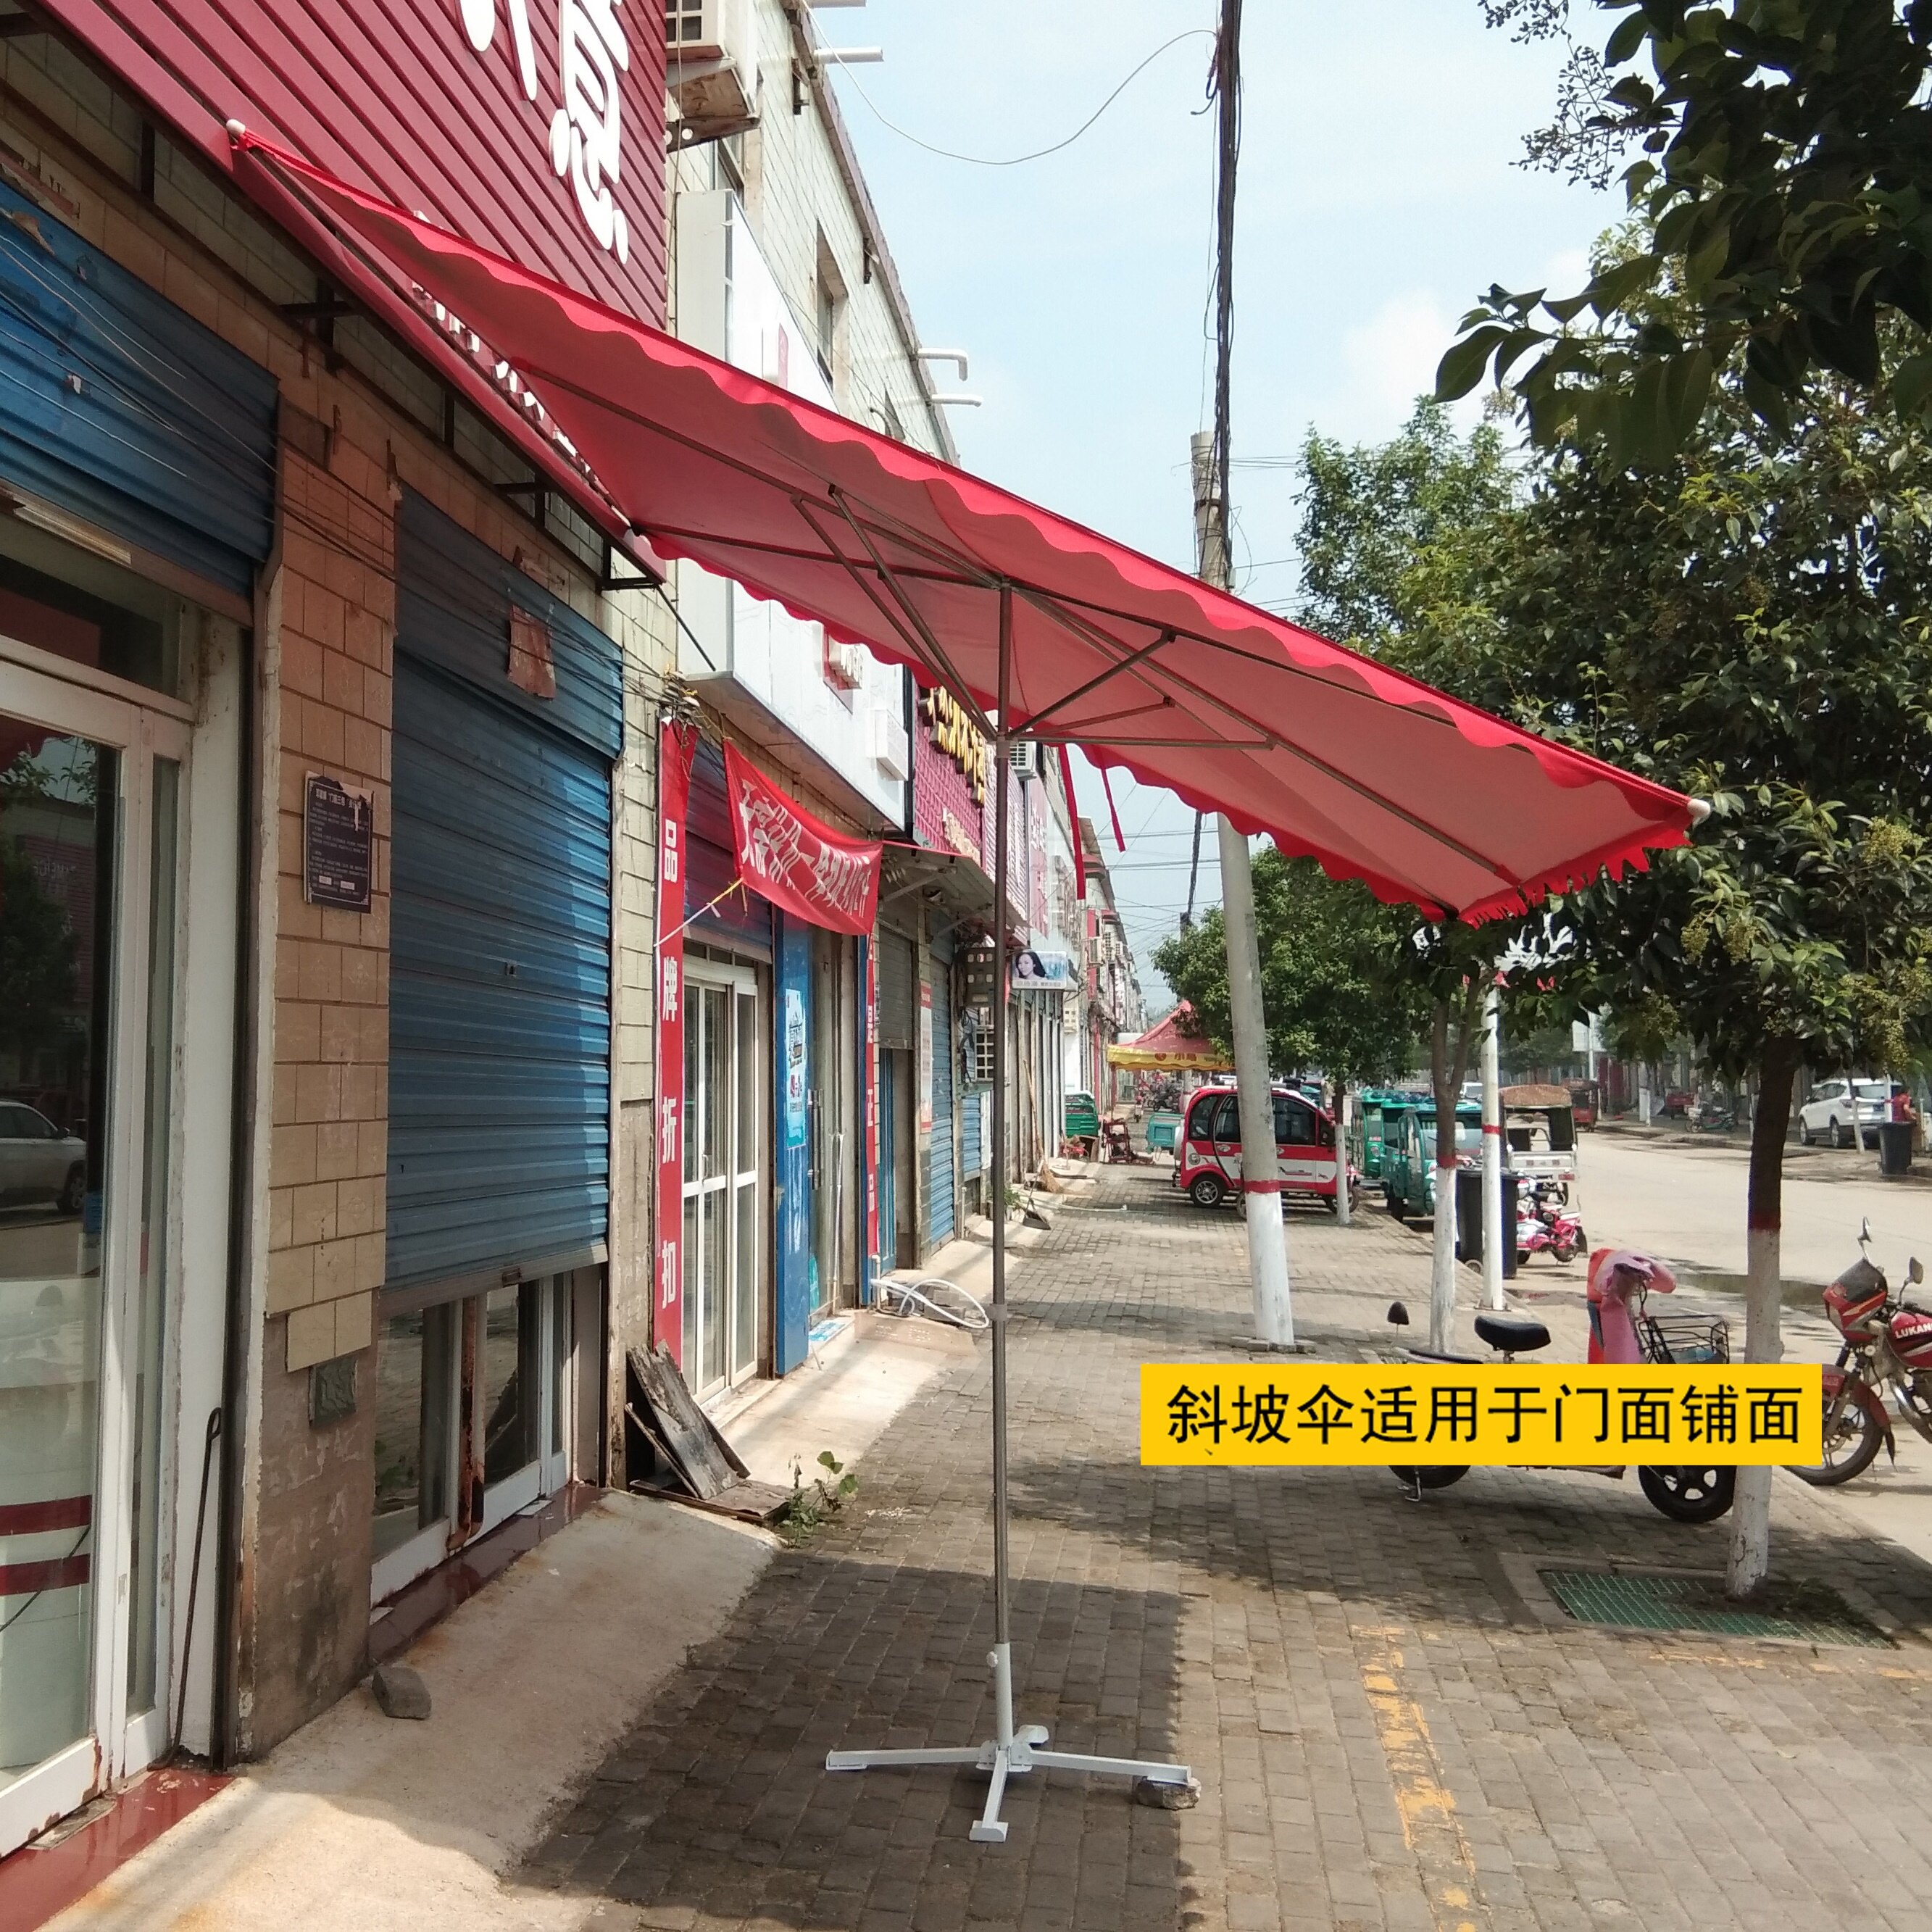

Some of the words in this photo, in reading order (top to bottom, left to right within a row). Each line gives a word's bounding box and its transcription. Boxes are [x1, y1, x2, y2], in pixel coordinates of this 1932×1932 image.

[662, 819, 678, 1309] 品牌折扣
[1894, 1322, 1932, 1338] LUKAN
